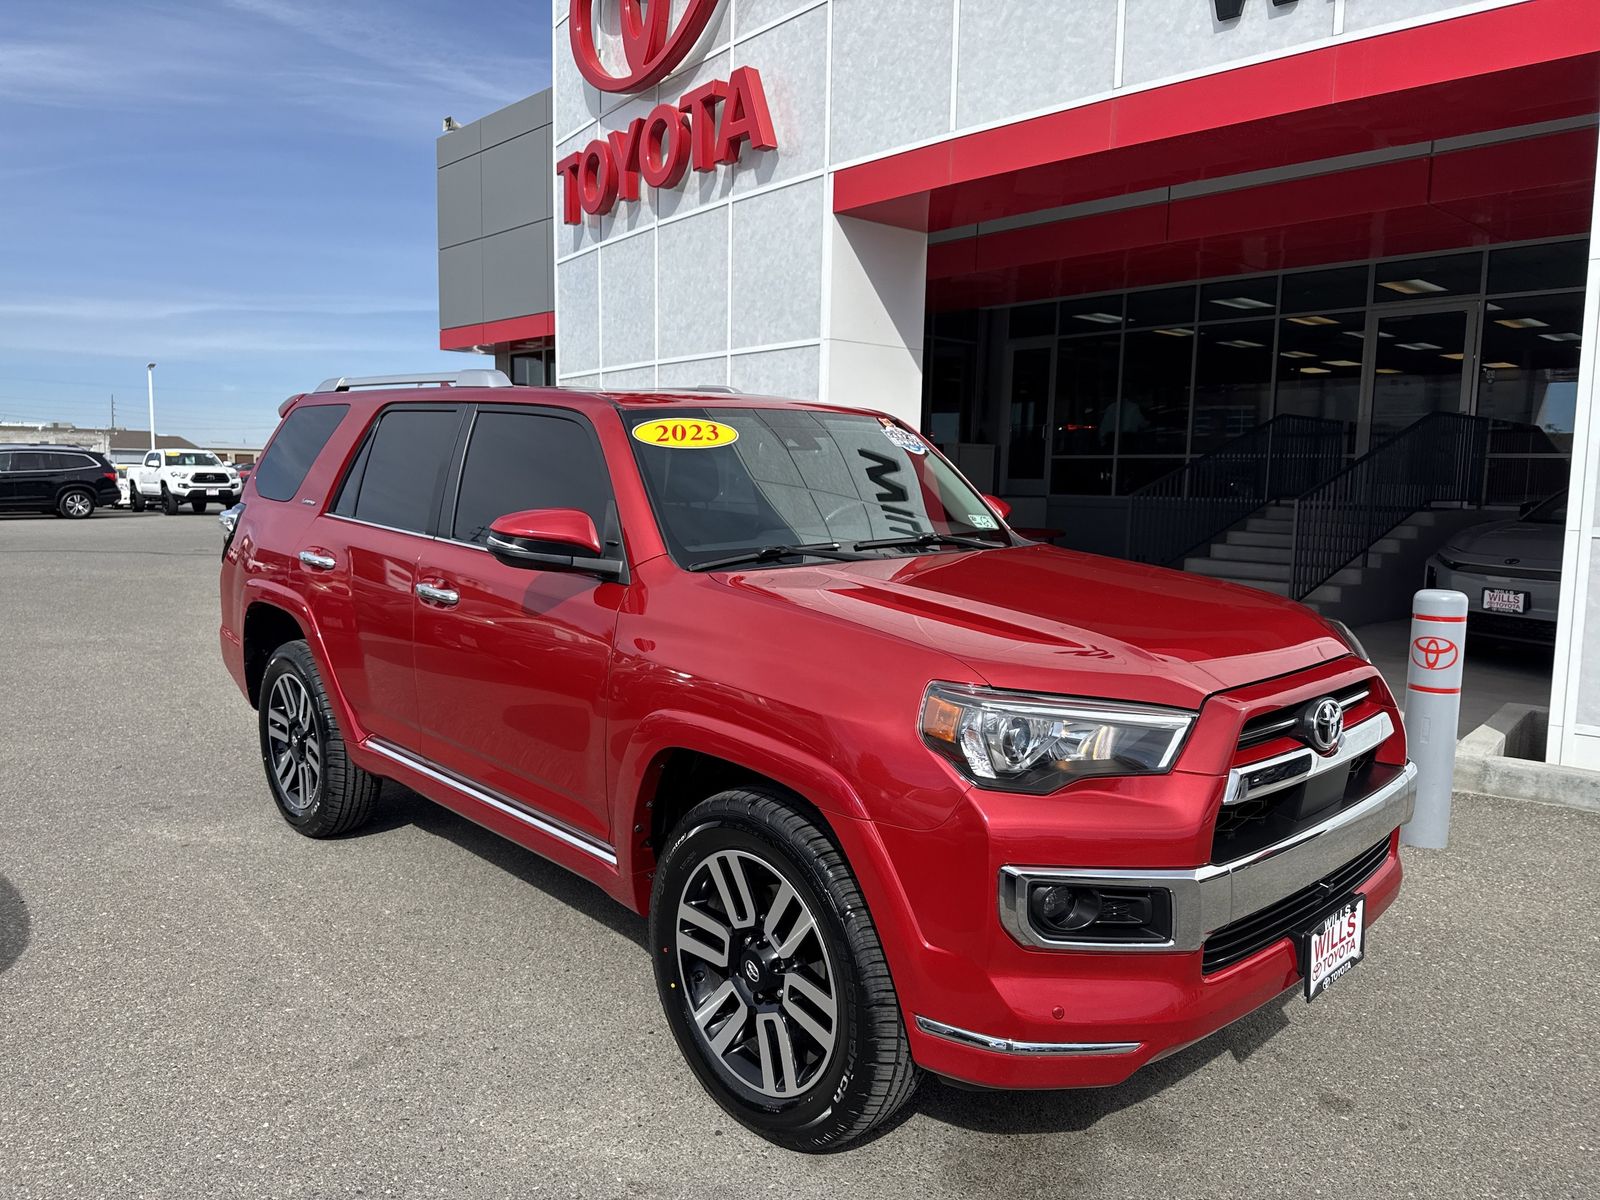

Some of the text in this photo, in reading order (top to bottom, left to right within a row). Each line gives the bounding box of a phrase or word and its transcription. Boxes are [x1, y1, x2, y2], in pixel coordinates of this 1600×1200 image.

[556, 65, 778, 226] TOYOTA
[655, 424, 719, 442] 2023
[1488, 592, 1520, 604] WILLS
[1496, 601, 1521, 609] TOYOTA
[1324, 904, 1351, 932] WILLS
[1314, 912, 1357, 963] WILLS
[1322, 938, 1356, 972] TOYOTA
[1330, 960, 1352, 983] TOYOTA
